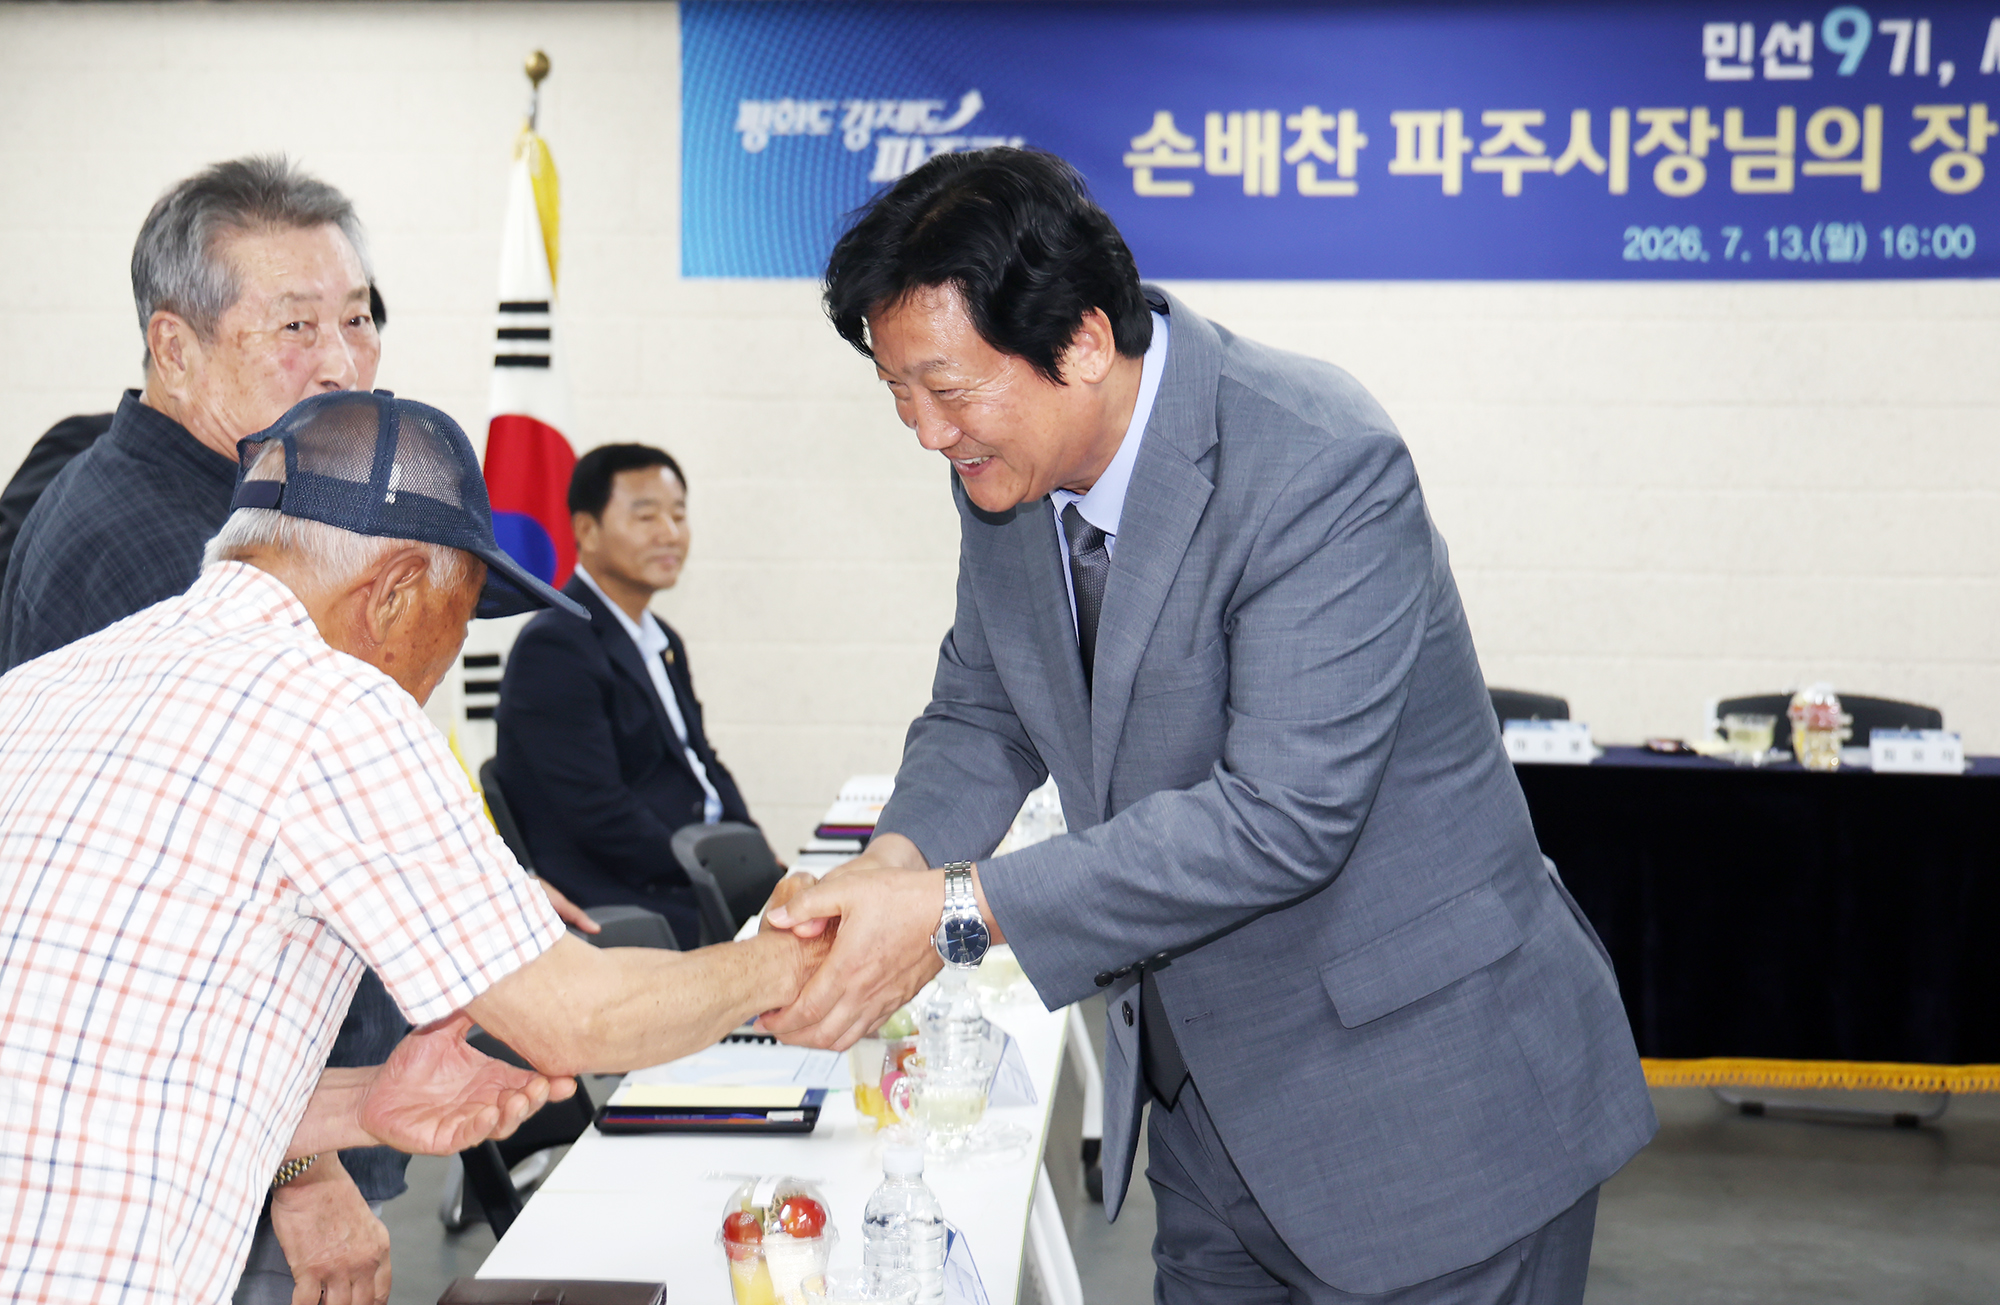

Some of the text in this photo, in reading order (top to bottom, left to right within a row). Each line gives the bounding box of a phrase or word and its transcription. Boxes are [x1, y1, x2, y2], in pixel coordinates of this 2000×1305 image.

[1702, 6, 1955, 87] 민선9기,
[1123, 106, 1368, 197] 손배찬
[1388, 104, 1883, 197] 파주시장님의
[1910, 103, 1999, 194] 장
[1623, 221, 1976, 264] 2026. 7. 13.(월) 16:00
